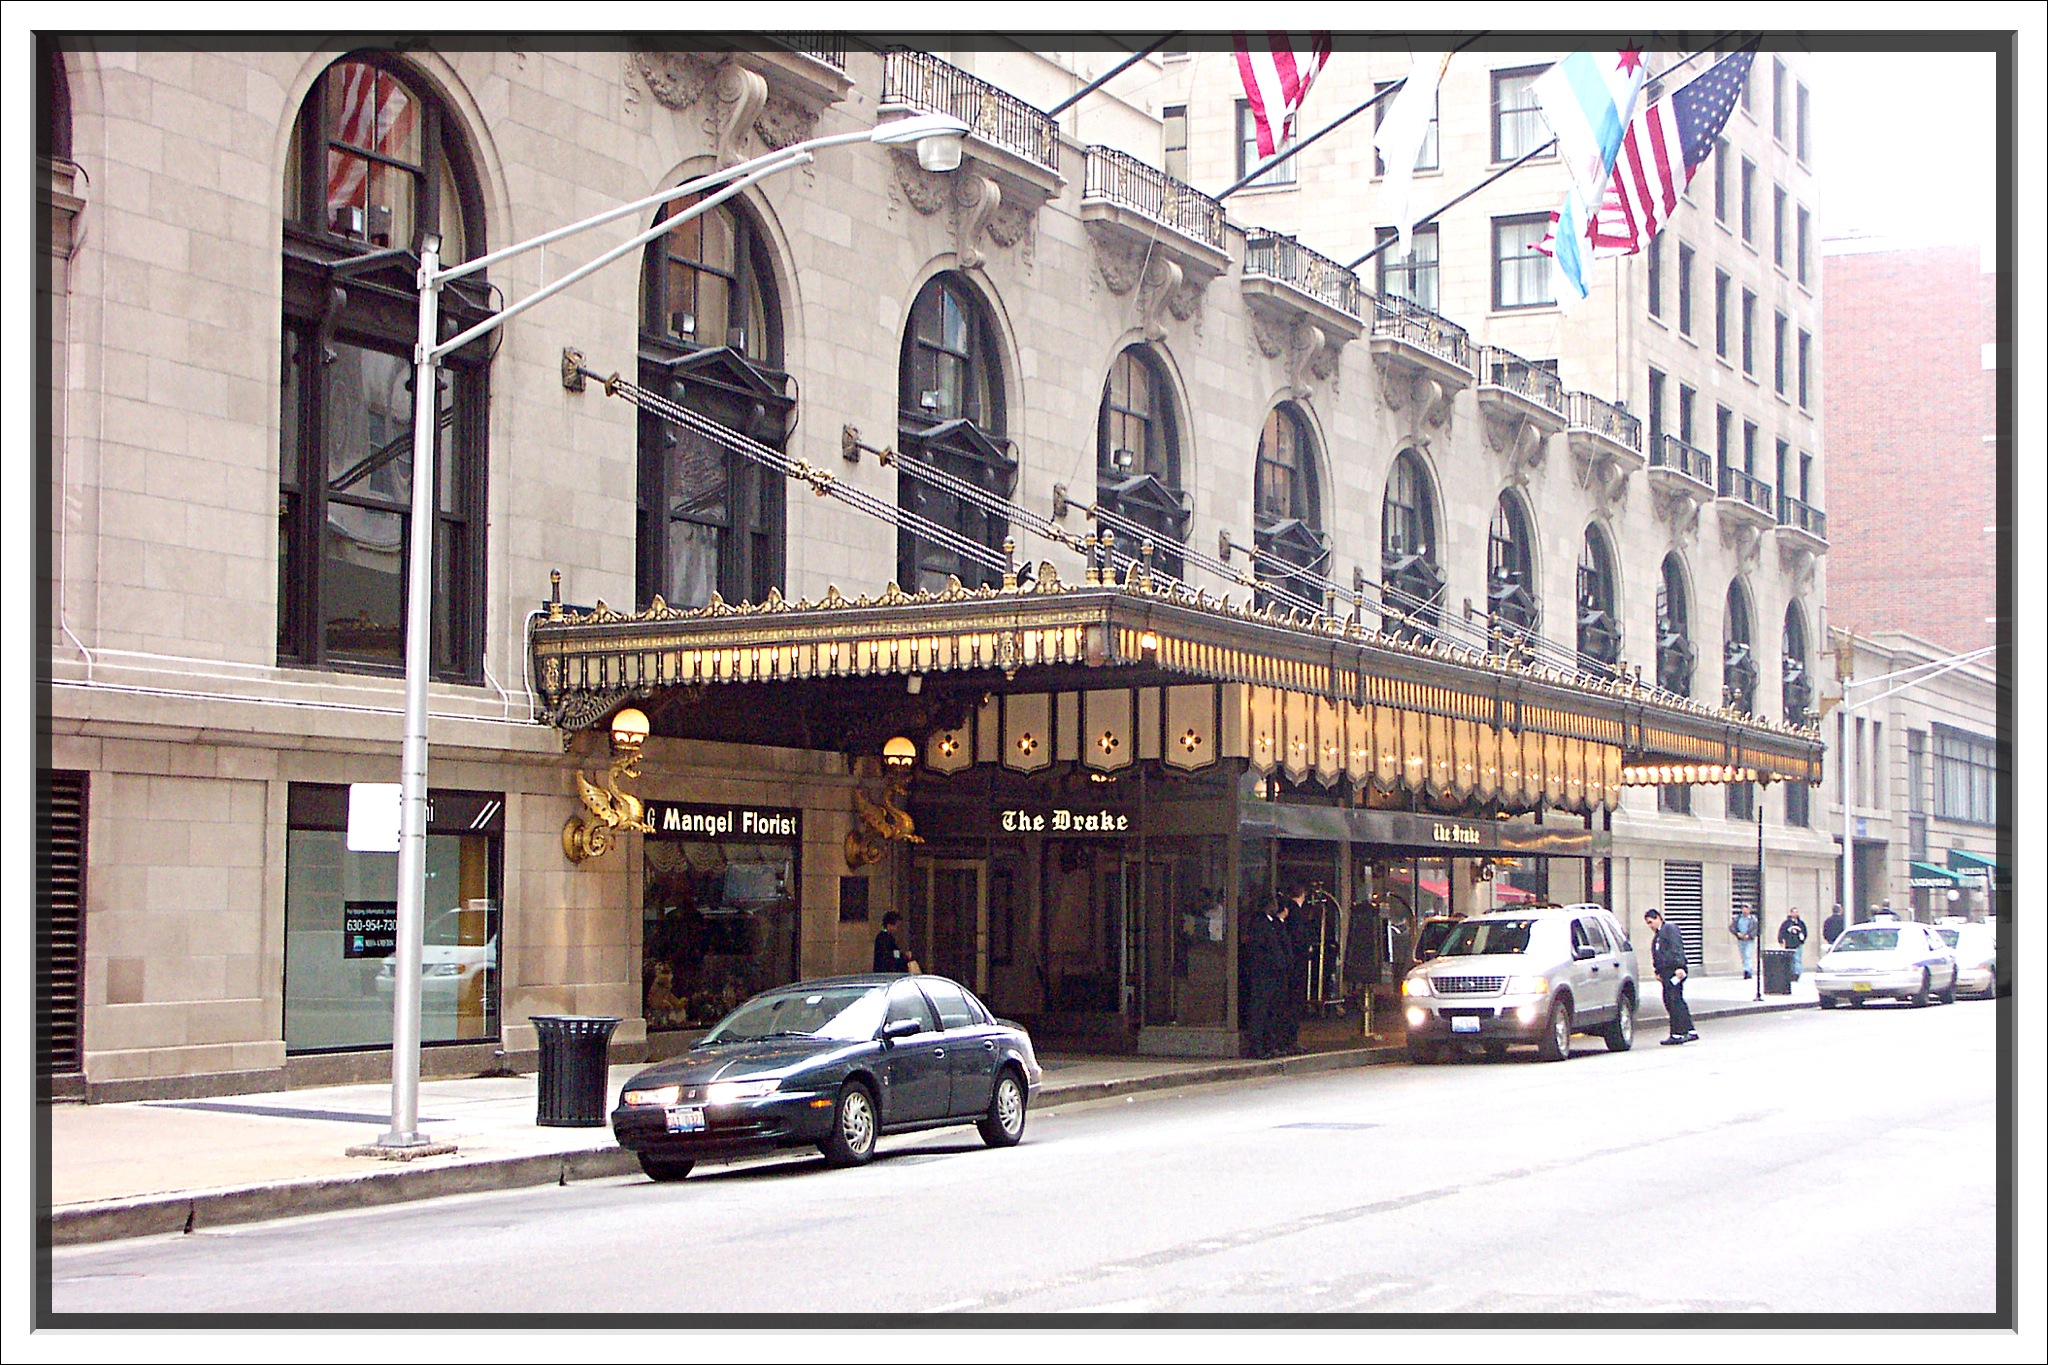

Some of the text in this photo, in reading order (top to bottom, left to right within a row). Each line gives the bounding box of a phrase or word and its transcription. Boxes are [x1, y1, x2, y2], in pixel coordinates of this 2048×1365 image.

[663, 807, 733, 837] Mangel
[742, 811, 797, 835] Florist
[1001, 809, 1129, 832] The Drake
